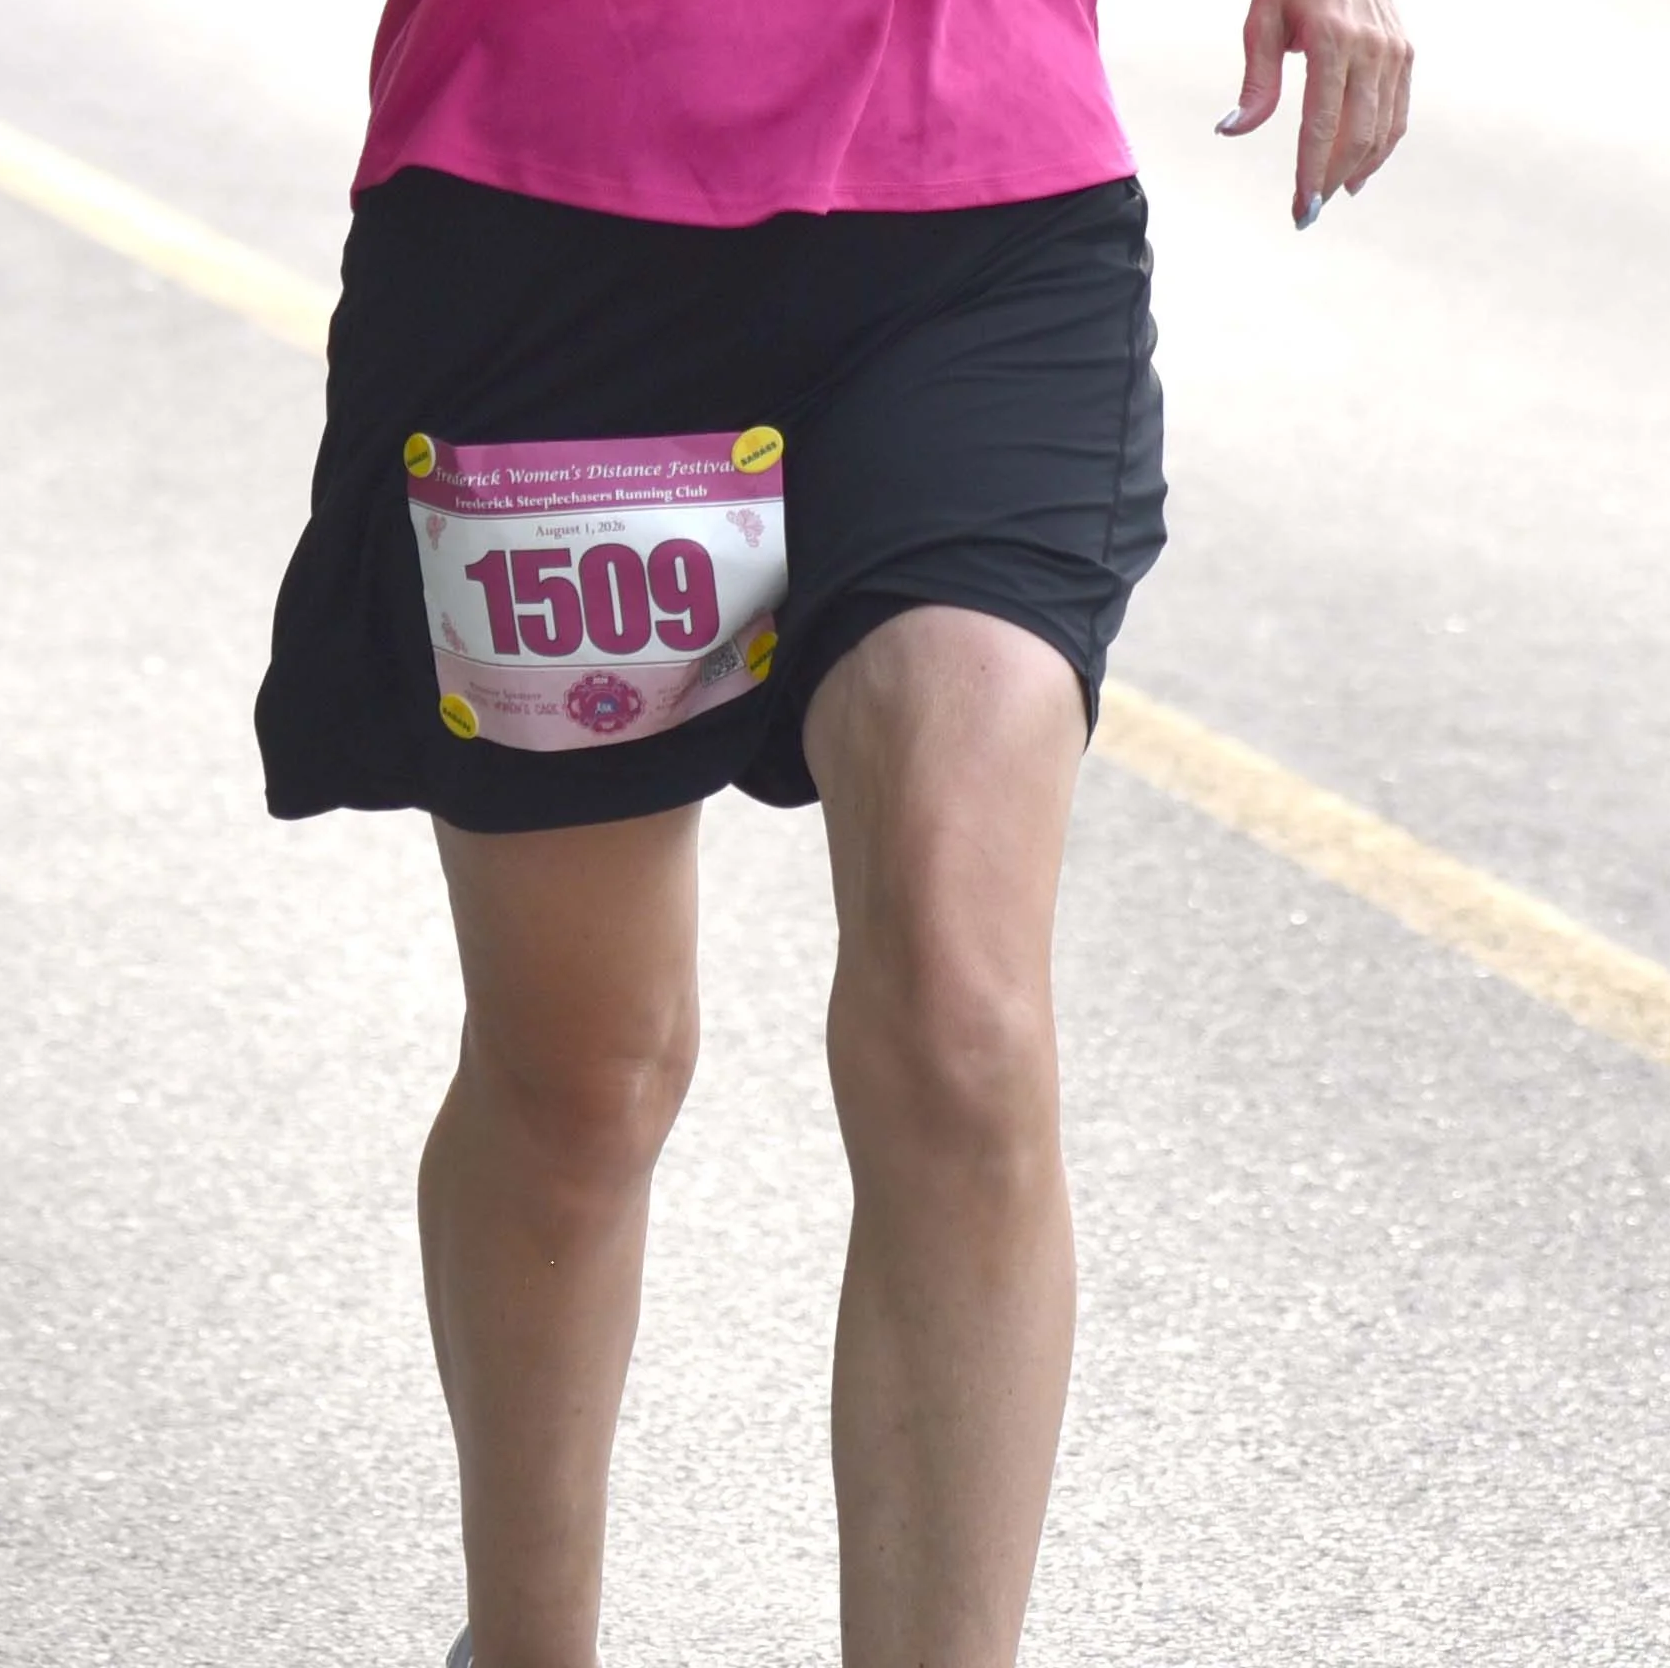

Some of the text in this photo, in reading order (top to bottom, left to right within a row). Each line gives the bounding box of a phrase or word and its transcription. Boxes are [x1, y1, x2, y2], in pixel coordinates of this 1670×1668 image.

[506, 464, 582, 485] Women's
[587, 463, 662, 480] Distance
[516, 490, 612, 509] Steeplechasers
[615, 485, 673, 503] Running
[676, 485, 708, 498] Club
[535, 522, 579, 539] August
[598, 520, 626, 533] 2026
[464, 537, 720, 658] 1509
